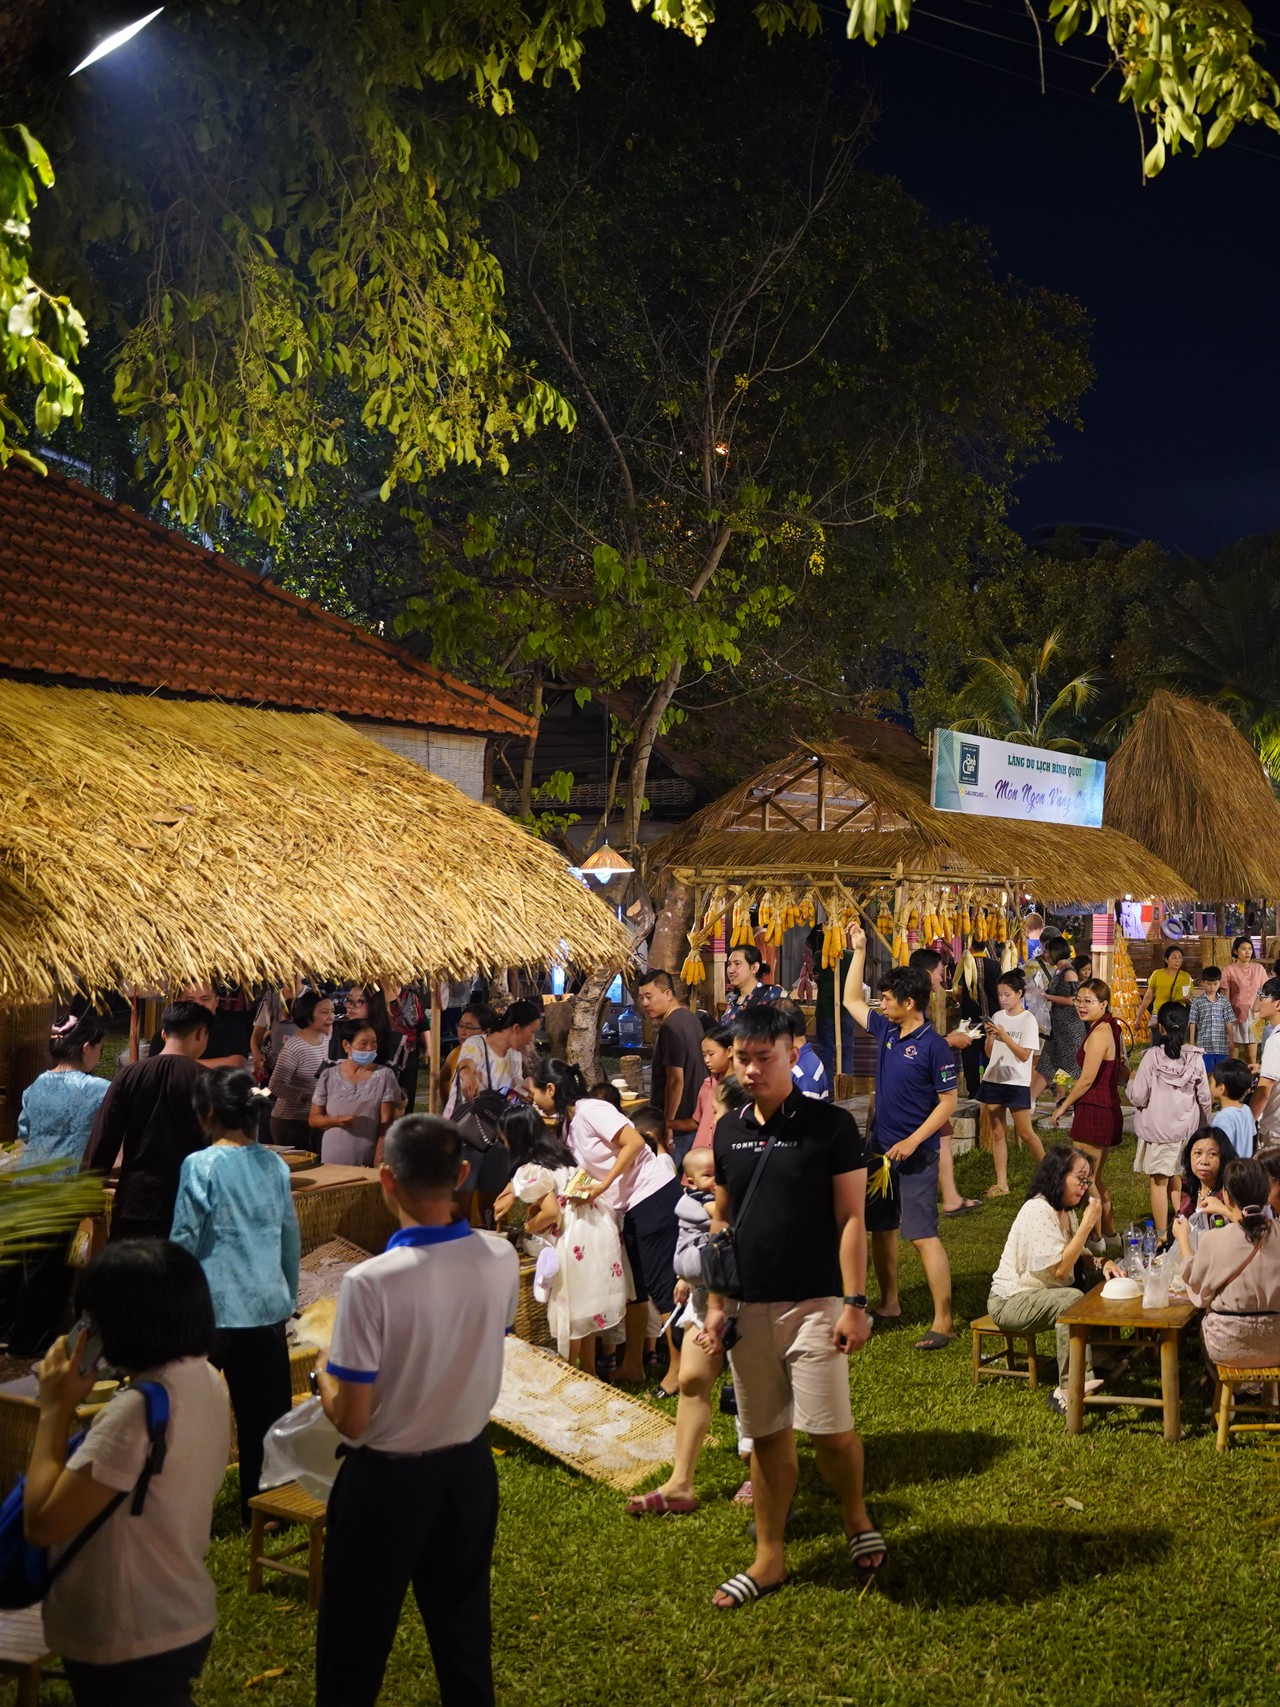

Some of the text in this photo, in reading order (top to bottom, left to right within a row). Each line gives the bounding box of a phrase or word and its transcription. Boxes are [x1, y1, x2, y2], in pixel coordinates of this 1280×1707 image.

[1026, 758, 1035, 769] DU
[1036, 760, 1051, 773] LỊCH
[994, 779, 1018, 800] Món
[1022, 783, 1045, 813] Ngon
[731, 1140, 758, 1150] TOMMY
